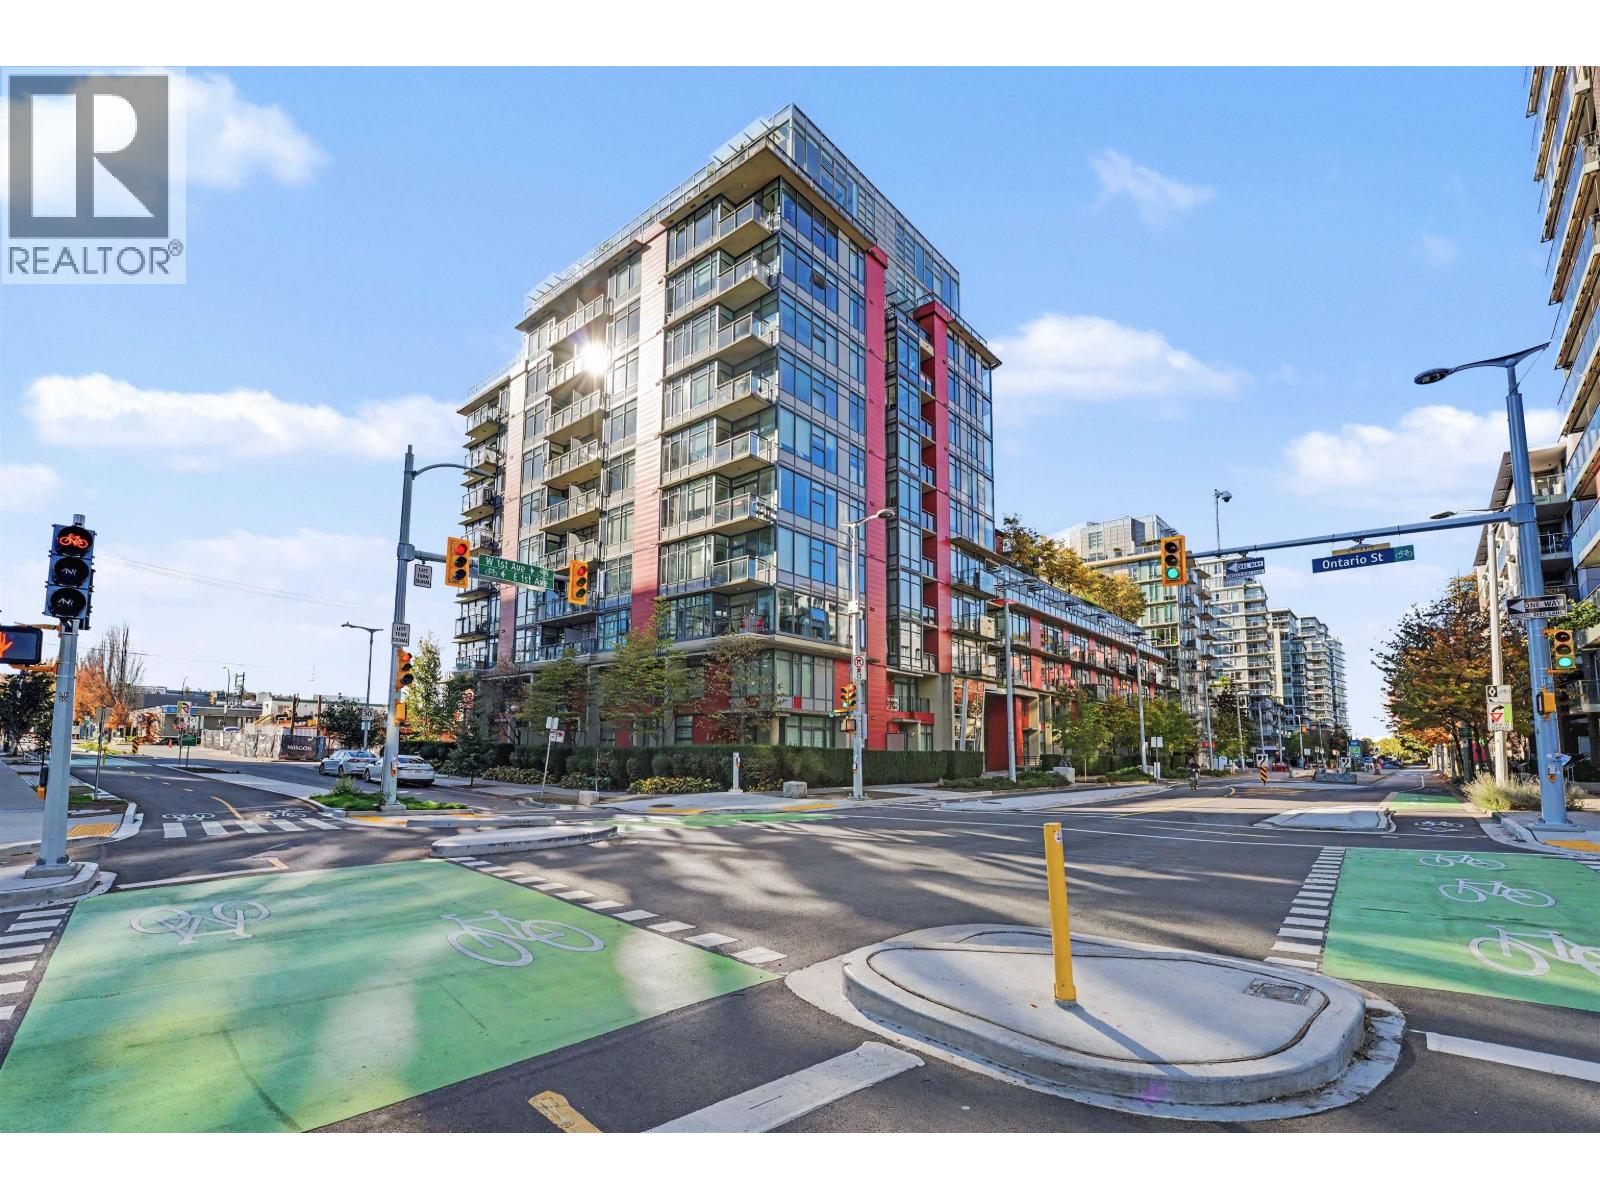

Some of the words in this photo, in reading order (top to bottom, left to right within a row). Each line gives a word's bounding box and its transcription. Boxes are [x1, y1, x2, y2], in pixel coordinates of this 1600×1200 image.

[485, 556, 494, 566] W
[497, 560, 508, 570] 1st
[511, 562, 526, 573] Ave
[1322, 555, 1368, 570] Ontario
[1371, 551, 1384, 563] St
[513, 572, 518, 581] E
[521, 574, 531, 584] 1st
[534, 577, 548, 588] Ave
[1523, 601, 1540, 609] ONE
[1544, 599, 1561, 607] WAY
